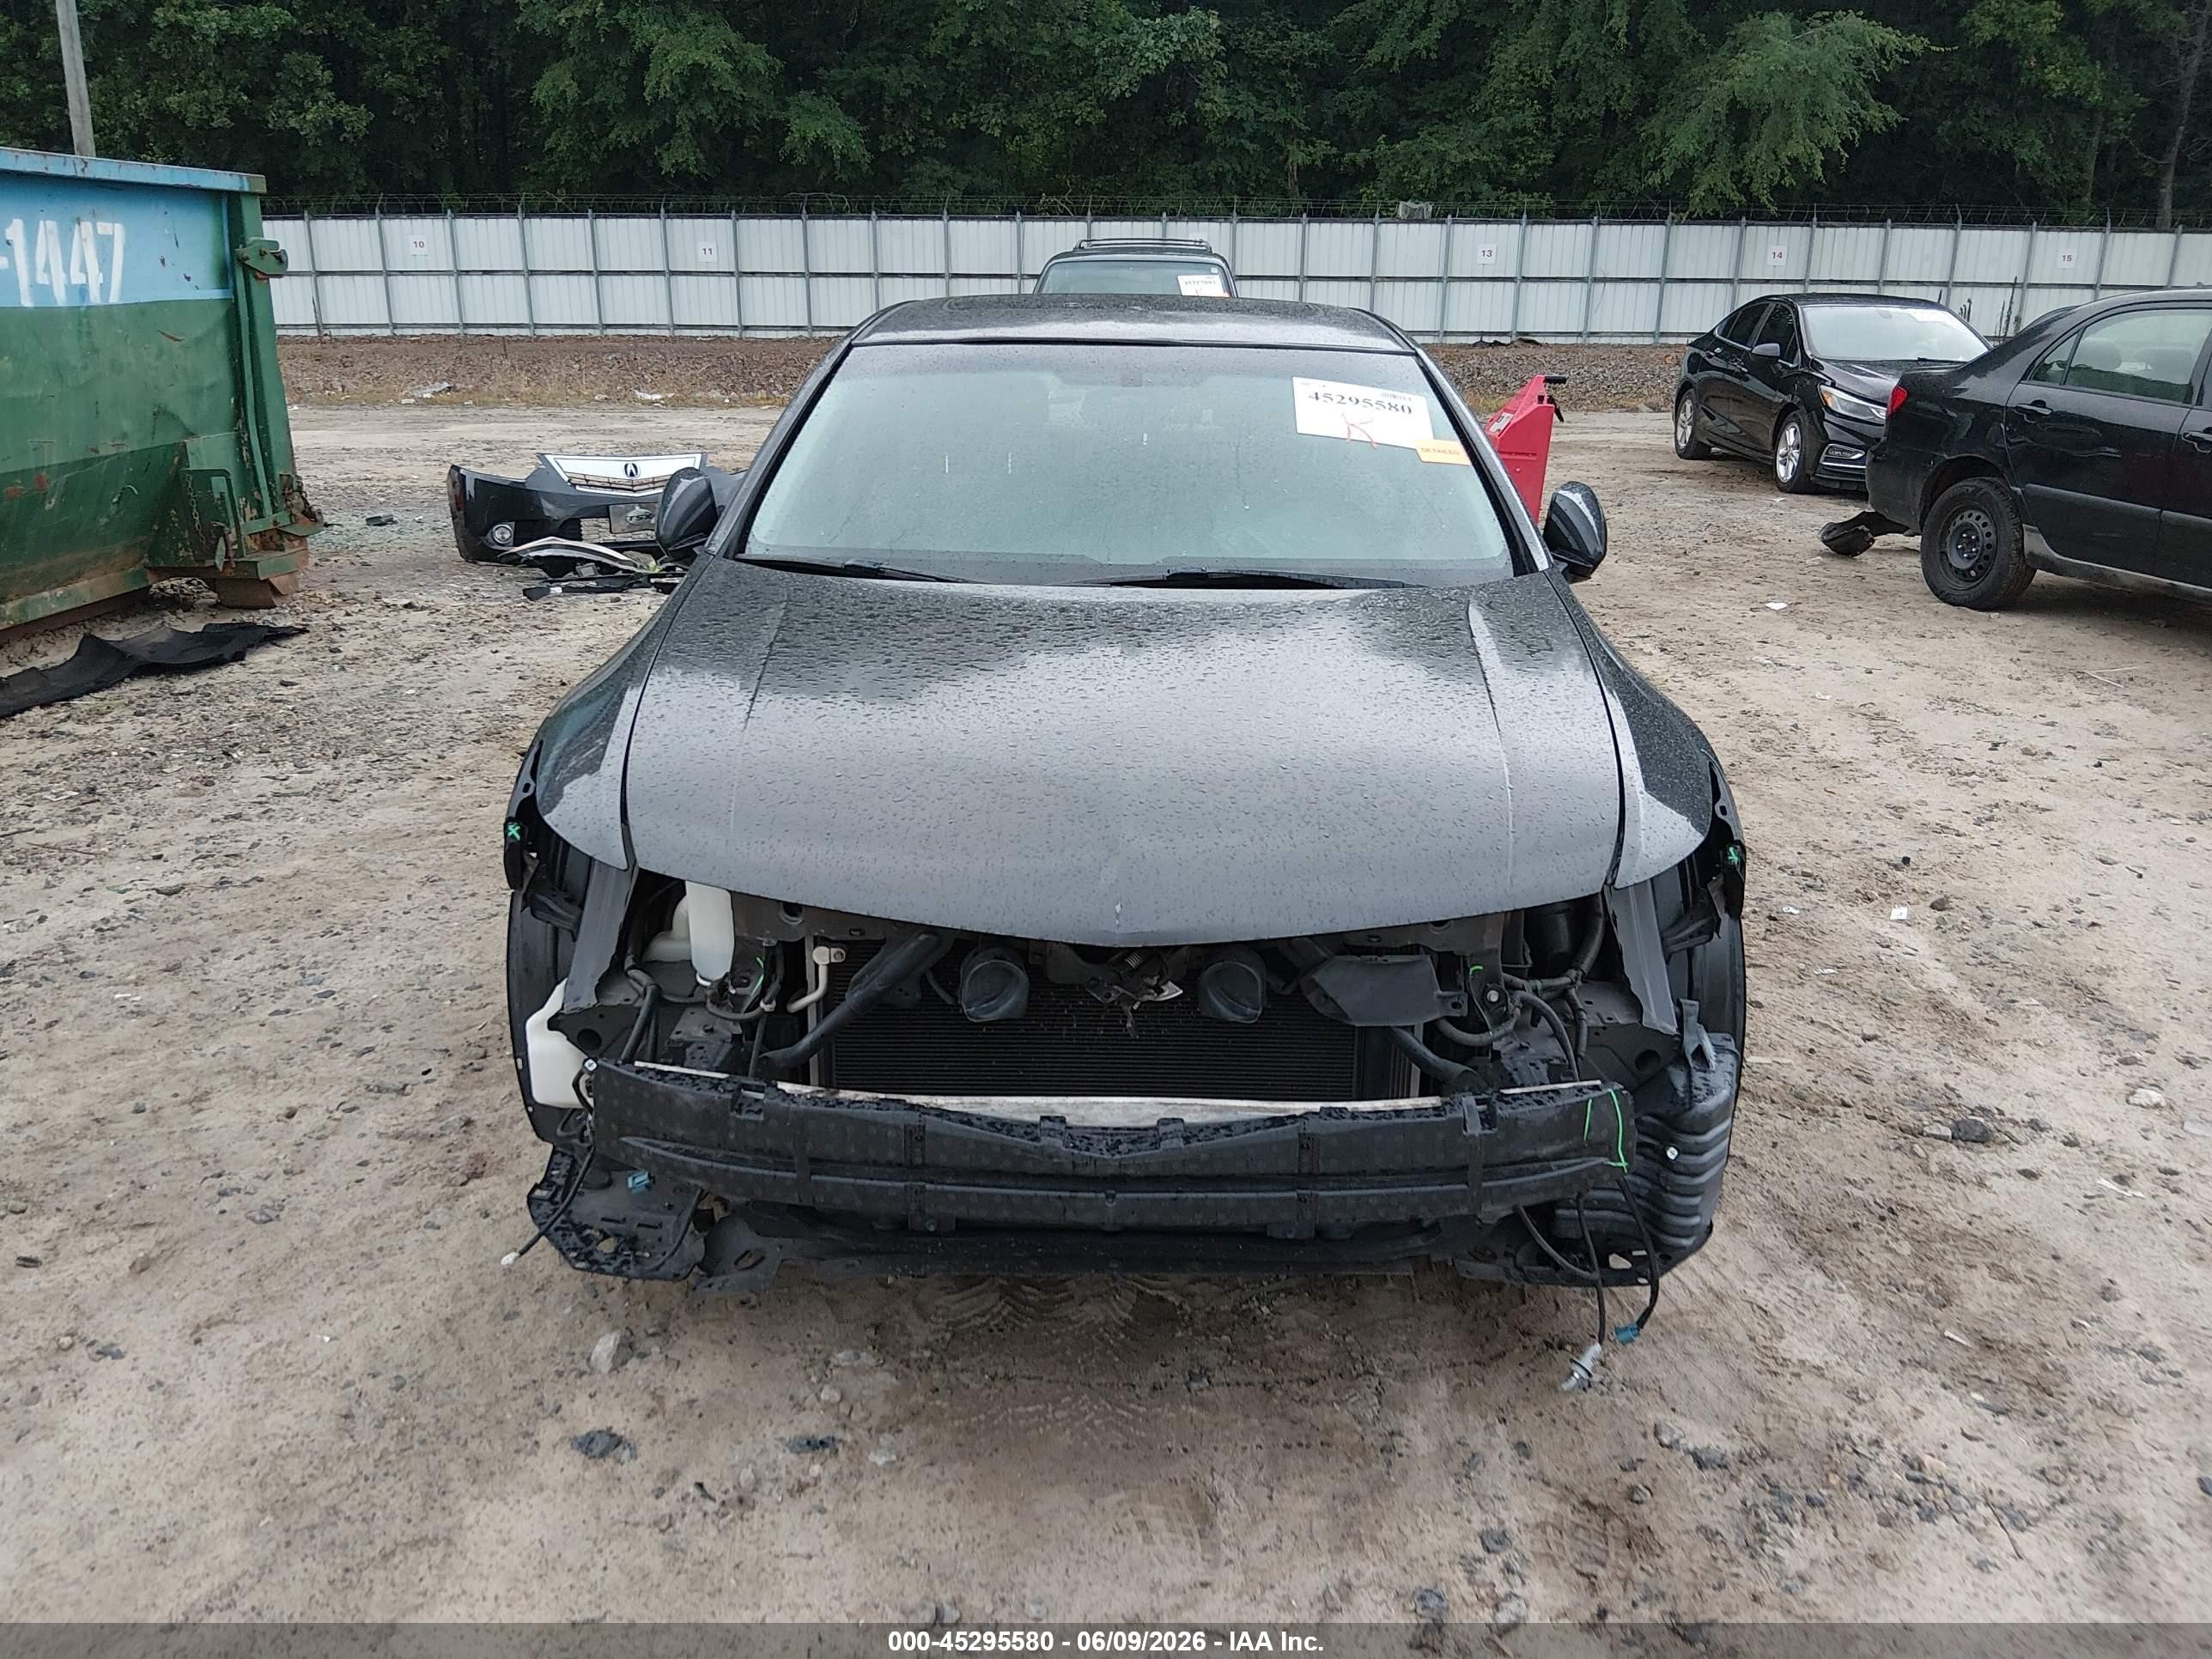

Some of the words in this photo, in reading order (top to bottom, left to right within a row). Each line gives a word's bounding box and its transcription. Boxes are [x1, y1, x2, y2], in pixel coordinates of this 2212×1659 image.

[1481, 249, 1492, 258] 13
[1771, 251, 1783, 259] 14
[1308, 392, 1413, 415] 45295580
